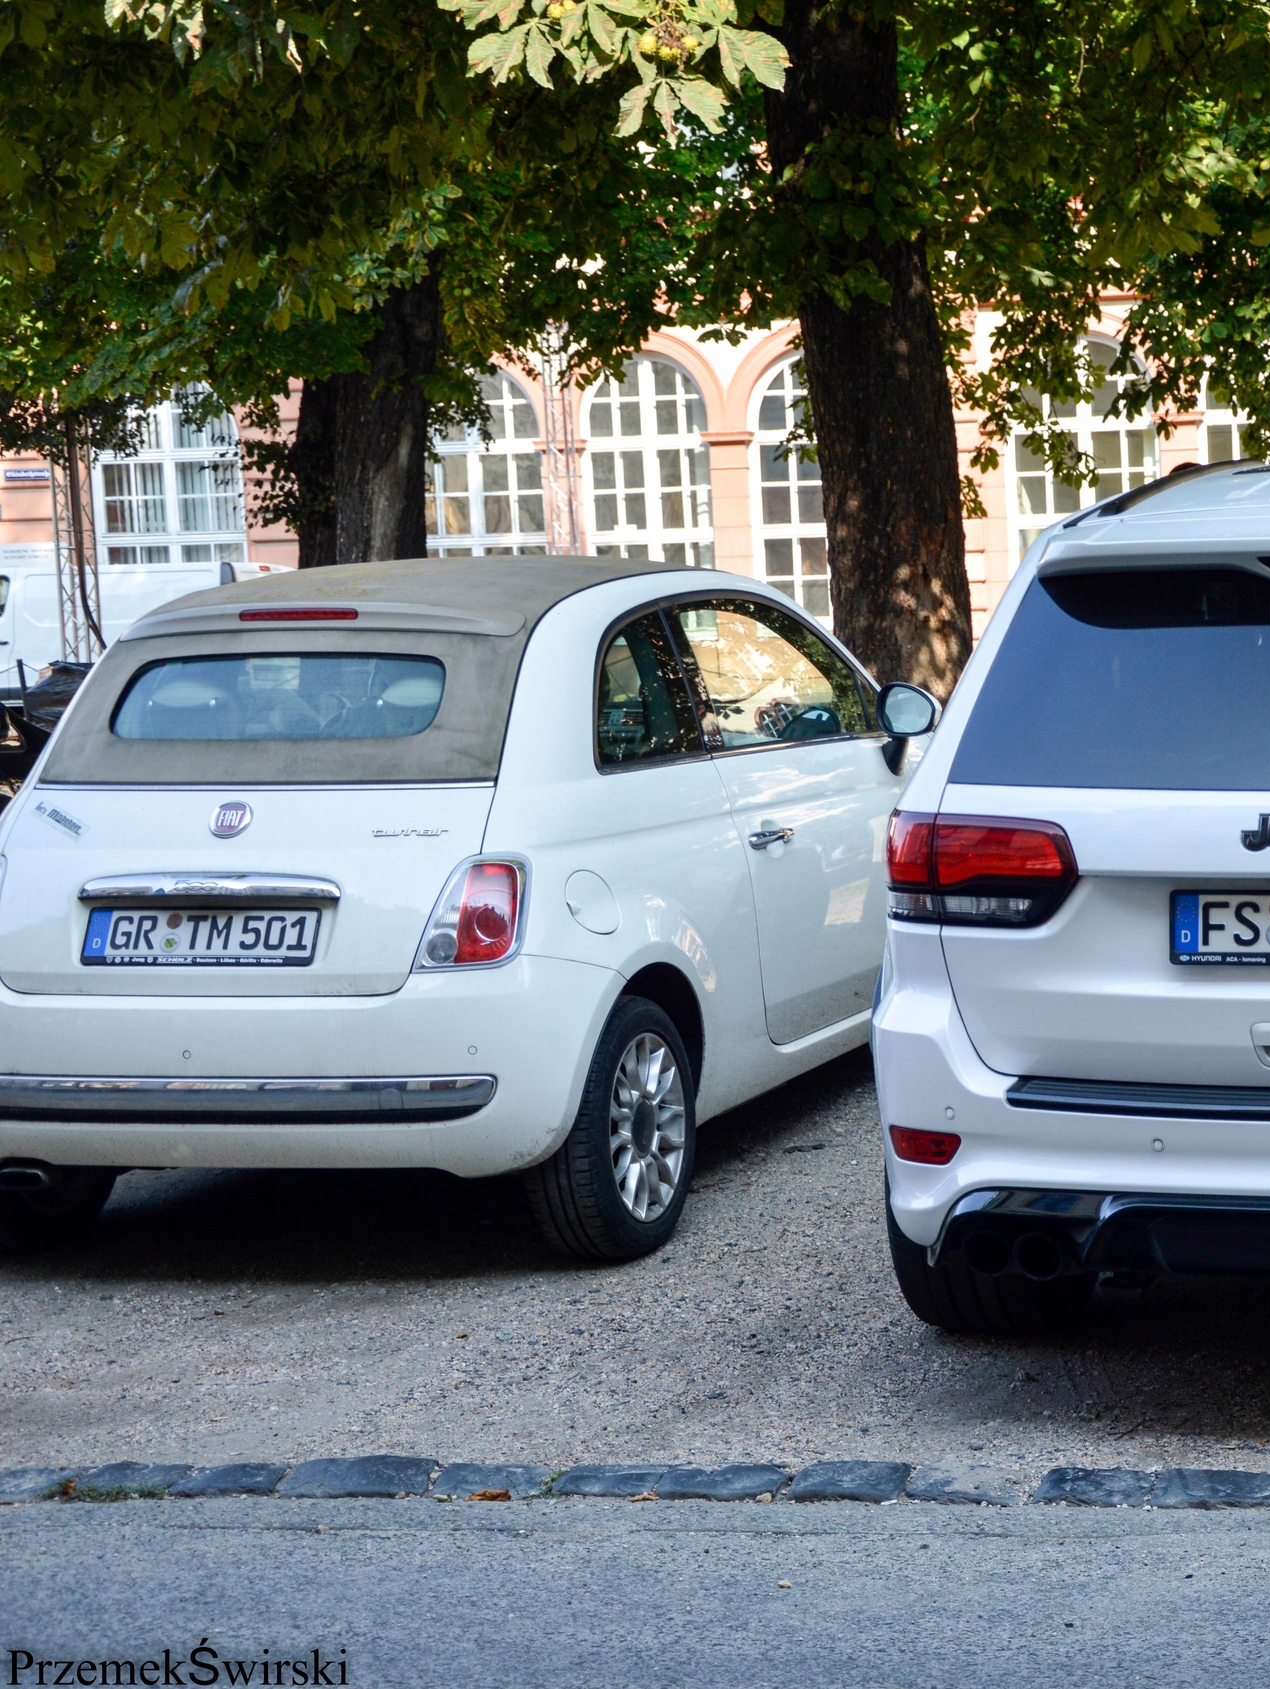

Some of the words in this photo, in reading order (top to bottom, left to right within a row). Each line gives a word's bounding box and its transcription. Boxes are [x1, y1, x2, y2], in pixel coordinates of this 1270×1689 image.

[217, 810, 244, 827] FIAT
[174, 879, 218, 892] 500
[1201, 901, 1261, 947] FS
[110, 915, 158, 950] GR
[186, 915, 234, 950] TM
[239, 915, 308, 951] 501
[1180, 930, 1191, 943] D
[92, 938, 101, 949] D
